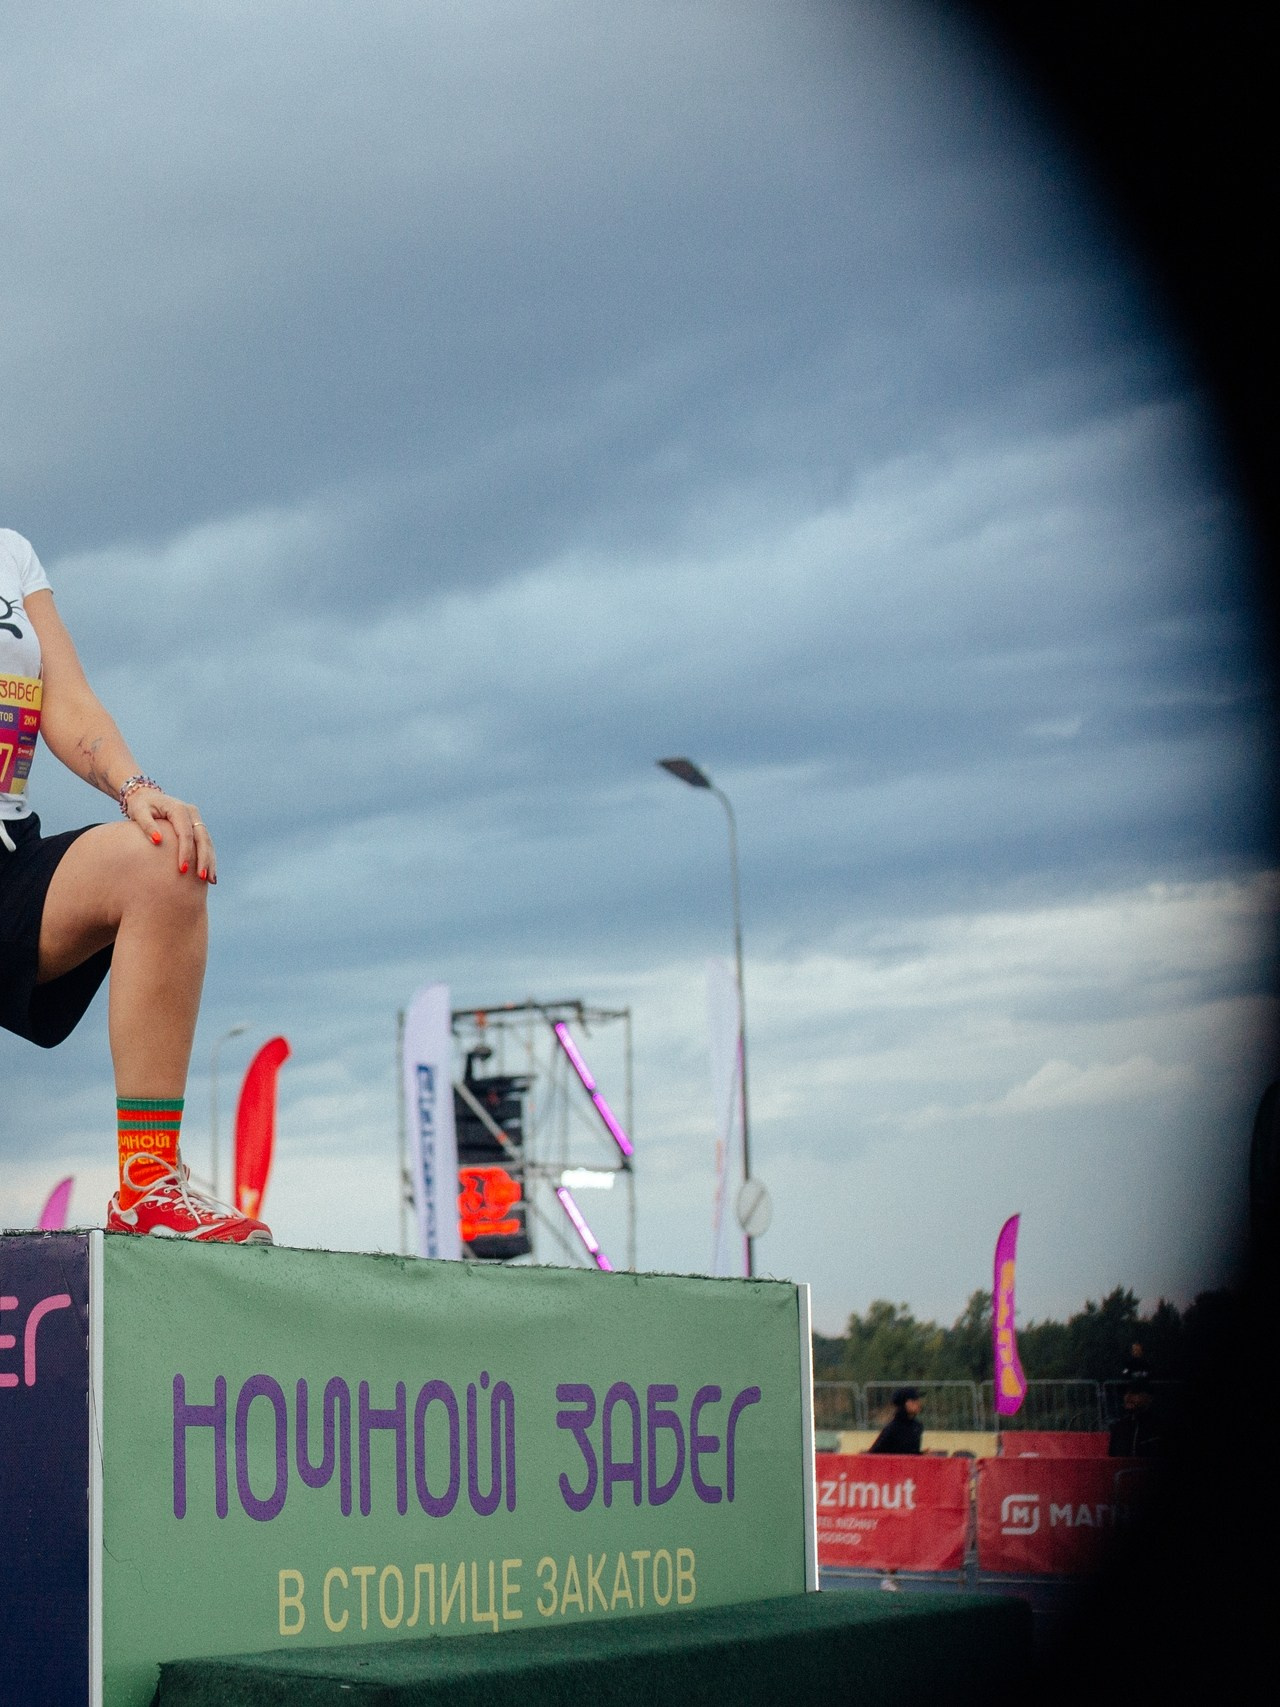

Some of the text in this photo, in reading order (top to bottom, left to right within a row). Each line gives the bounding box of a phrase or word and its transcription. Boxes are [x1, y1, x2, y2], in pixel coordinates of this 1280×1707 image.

[0, 679, 39, 703] ЗАБЕГ
[172, 1370, 762, 1522] НОЧНОЙ ЗАБЕГ
[817, 1471, 917, 1510] zimut
[278, 1548, 697, 1636] В СТОЛИЦЕ ЗАКАТОВ
